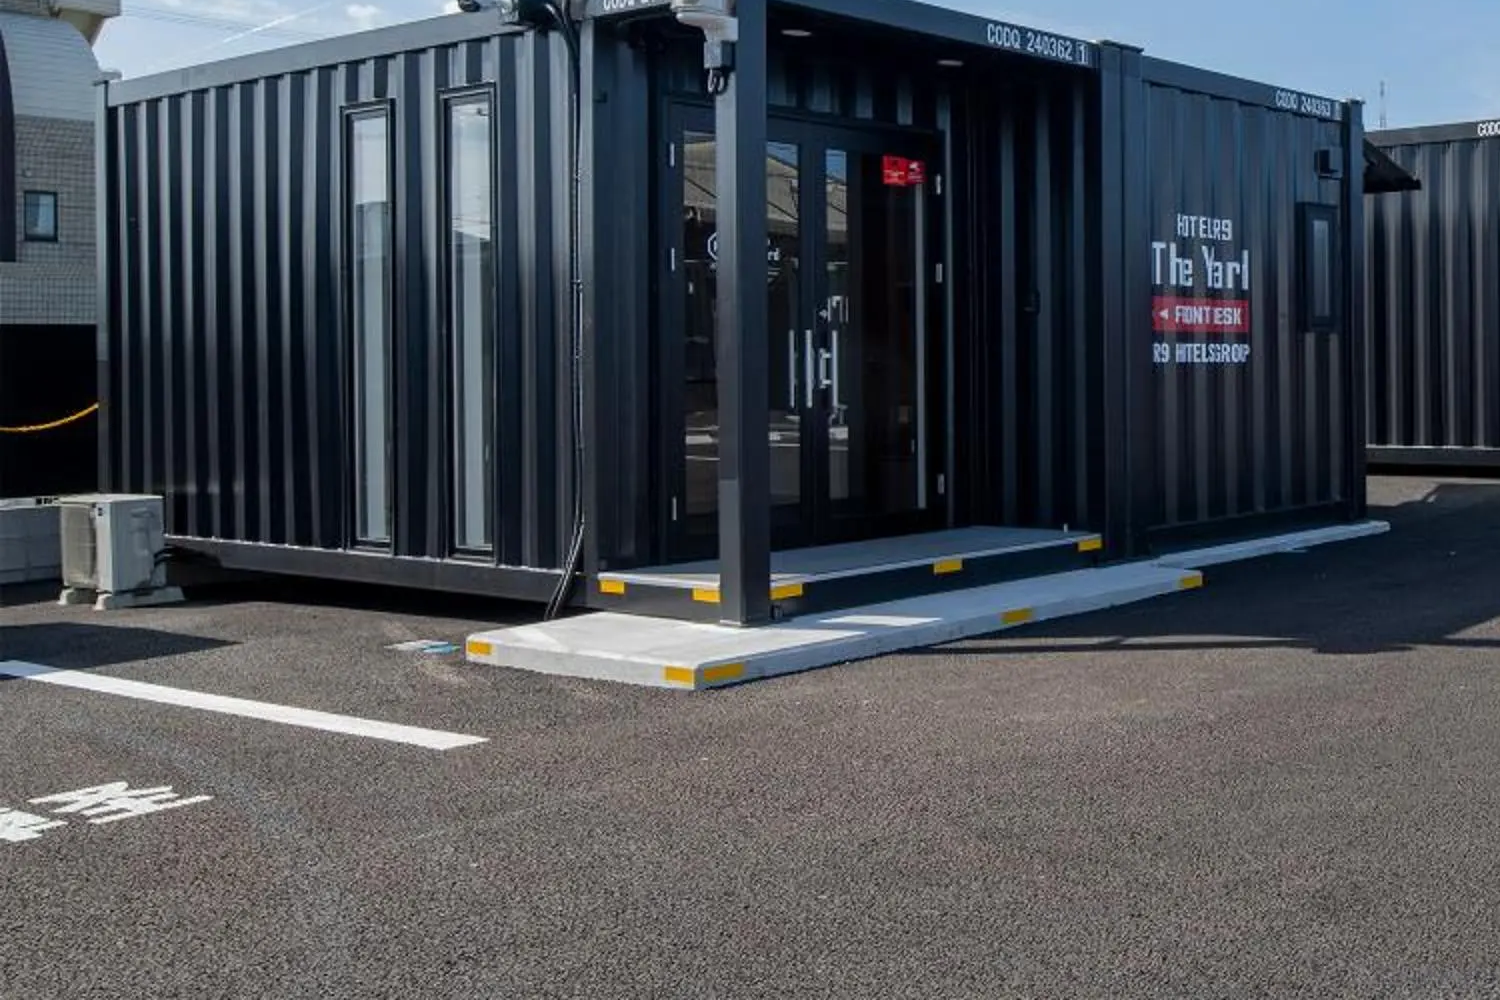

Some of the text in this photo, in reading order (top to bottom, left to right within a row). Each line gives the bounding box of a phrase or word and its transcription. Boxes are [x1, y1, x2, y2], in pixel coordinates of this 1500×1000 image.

[986, 23, 1020, 49] CODQ
[1026, 31, 1073, 61] 240362
[1152, 241, 1193, 287] The
[1153, 342, 1170, 363] R9
